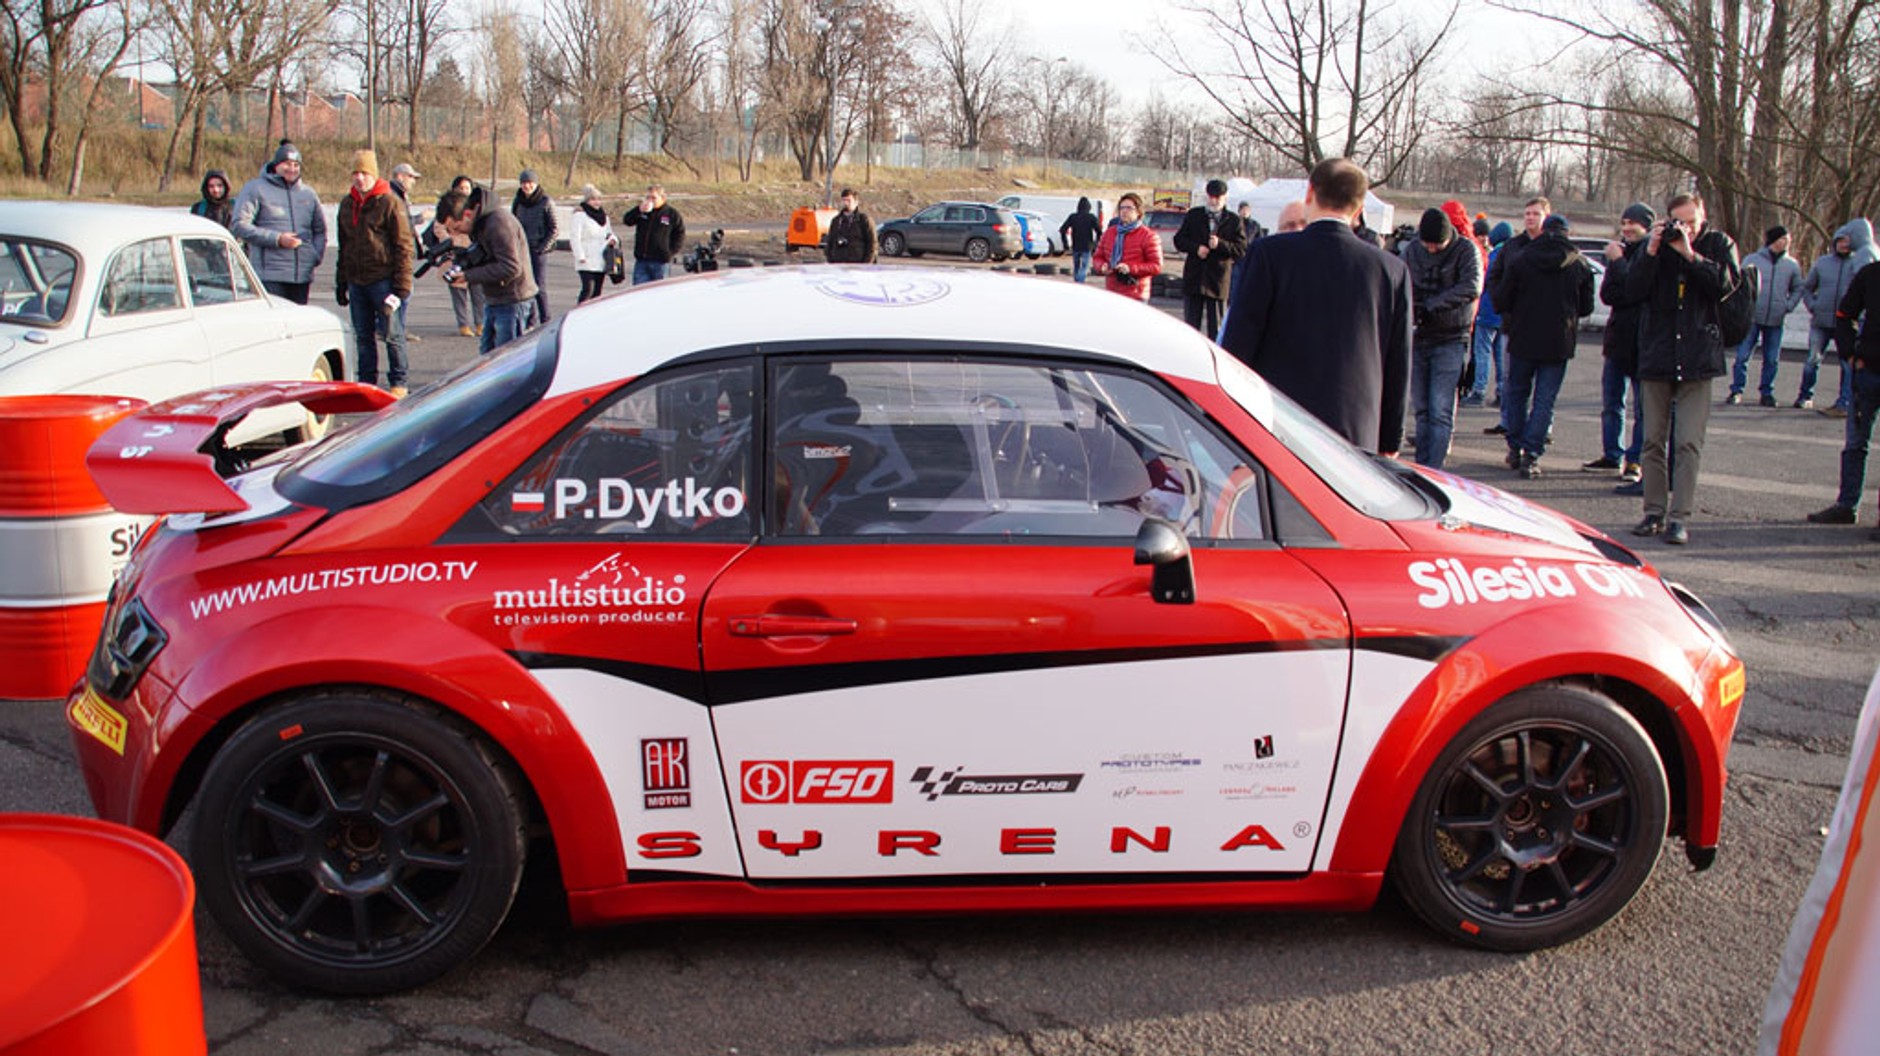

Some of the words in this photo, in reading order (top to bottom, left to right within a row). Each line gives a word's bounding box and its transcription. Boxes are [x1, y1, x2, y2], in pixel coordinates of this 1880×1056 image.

[555, 478, 744, 528] P.Dytko
[190, 561, 478, 620] WWW.MULTISTUDIO.TV
[494, 577, 686, 608] multistudio
[1408, 558, 1576, 609] Silesia
[494, 612, 590, 626] television
[599, 610, 686, 626] producer
[645, 741, 686, 788] AK
[797, 767, 888, 798] FSO
[647, 795, 688, 807] MOTOR
